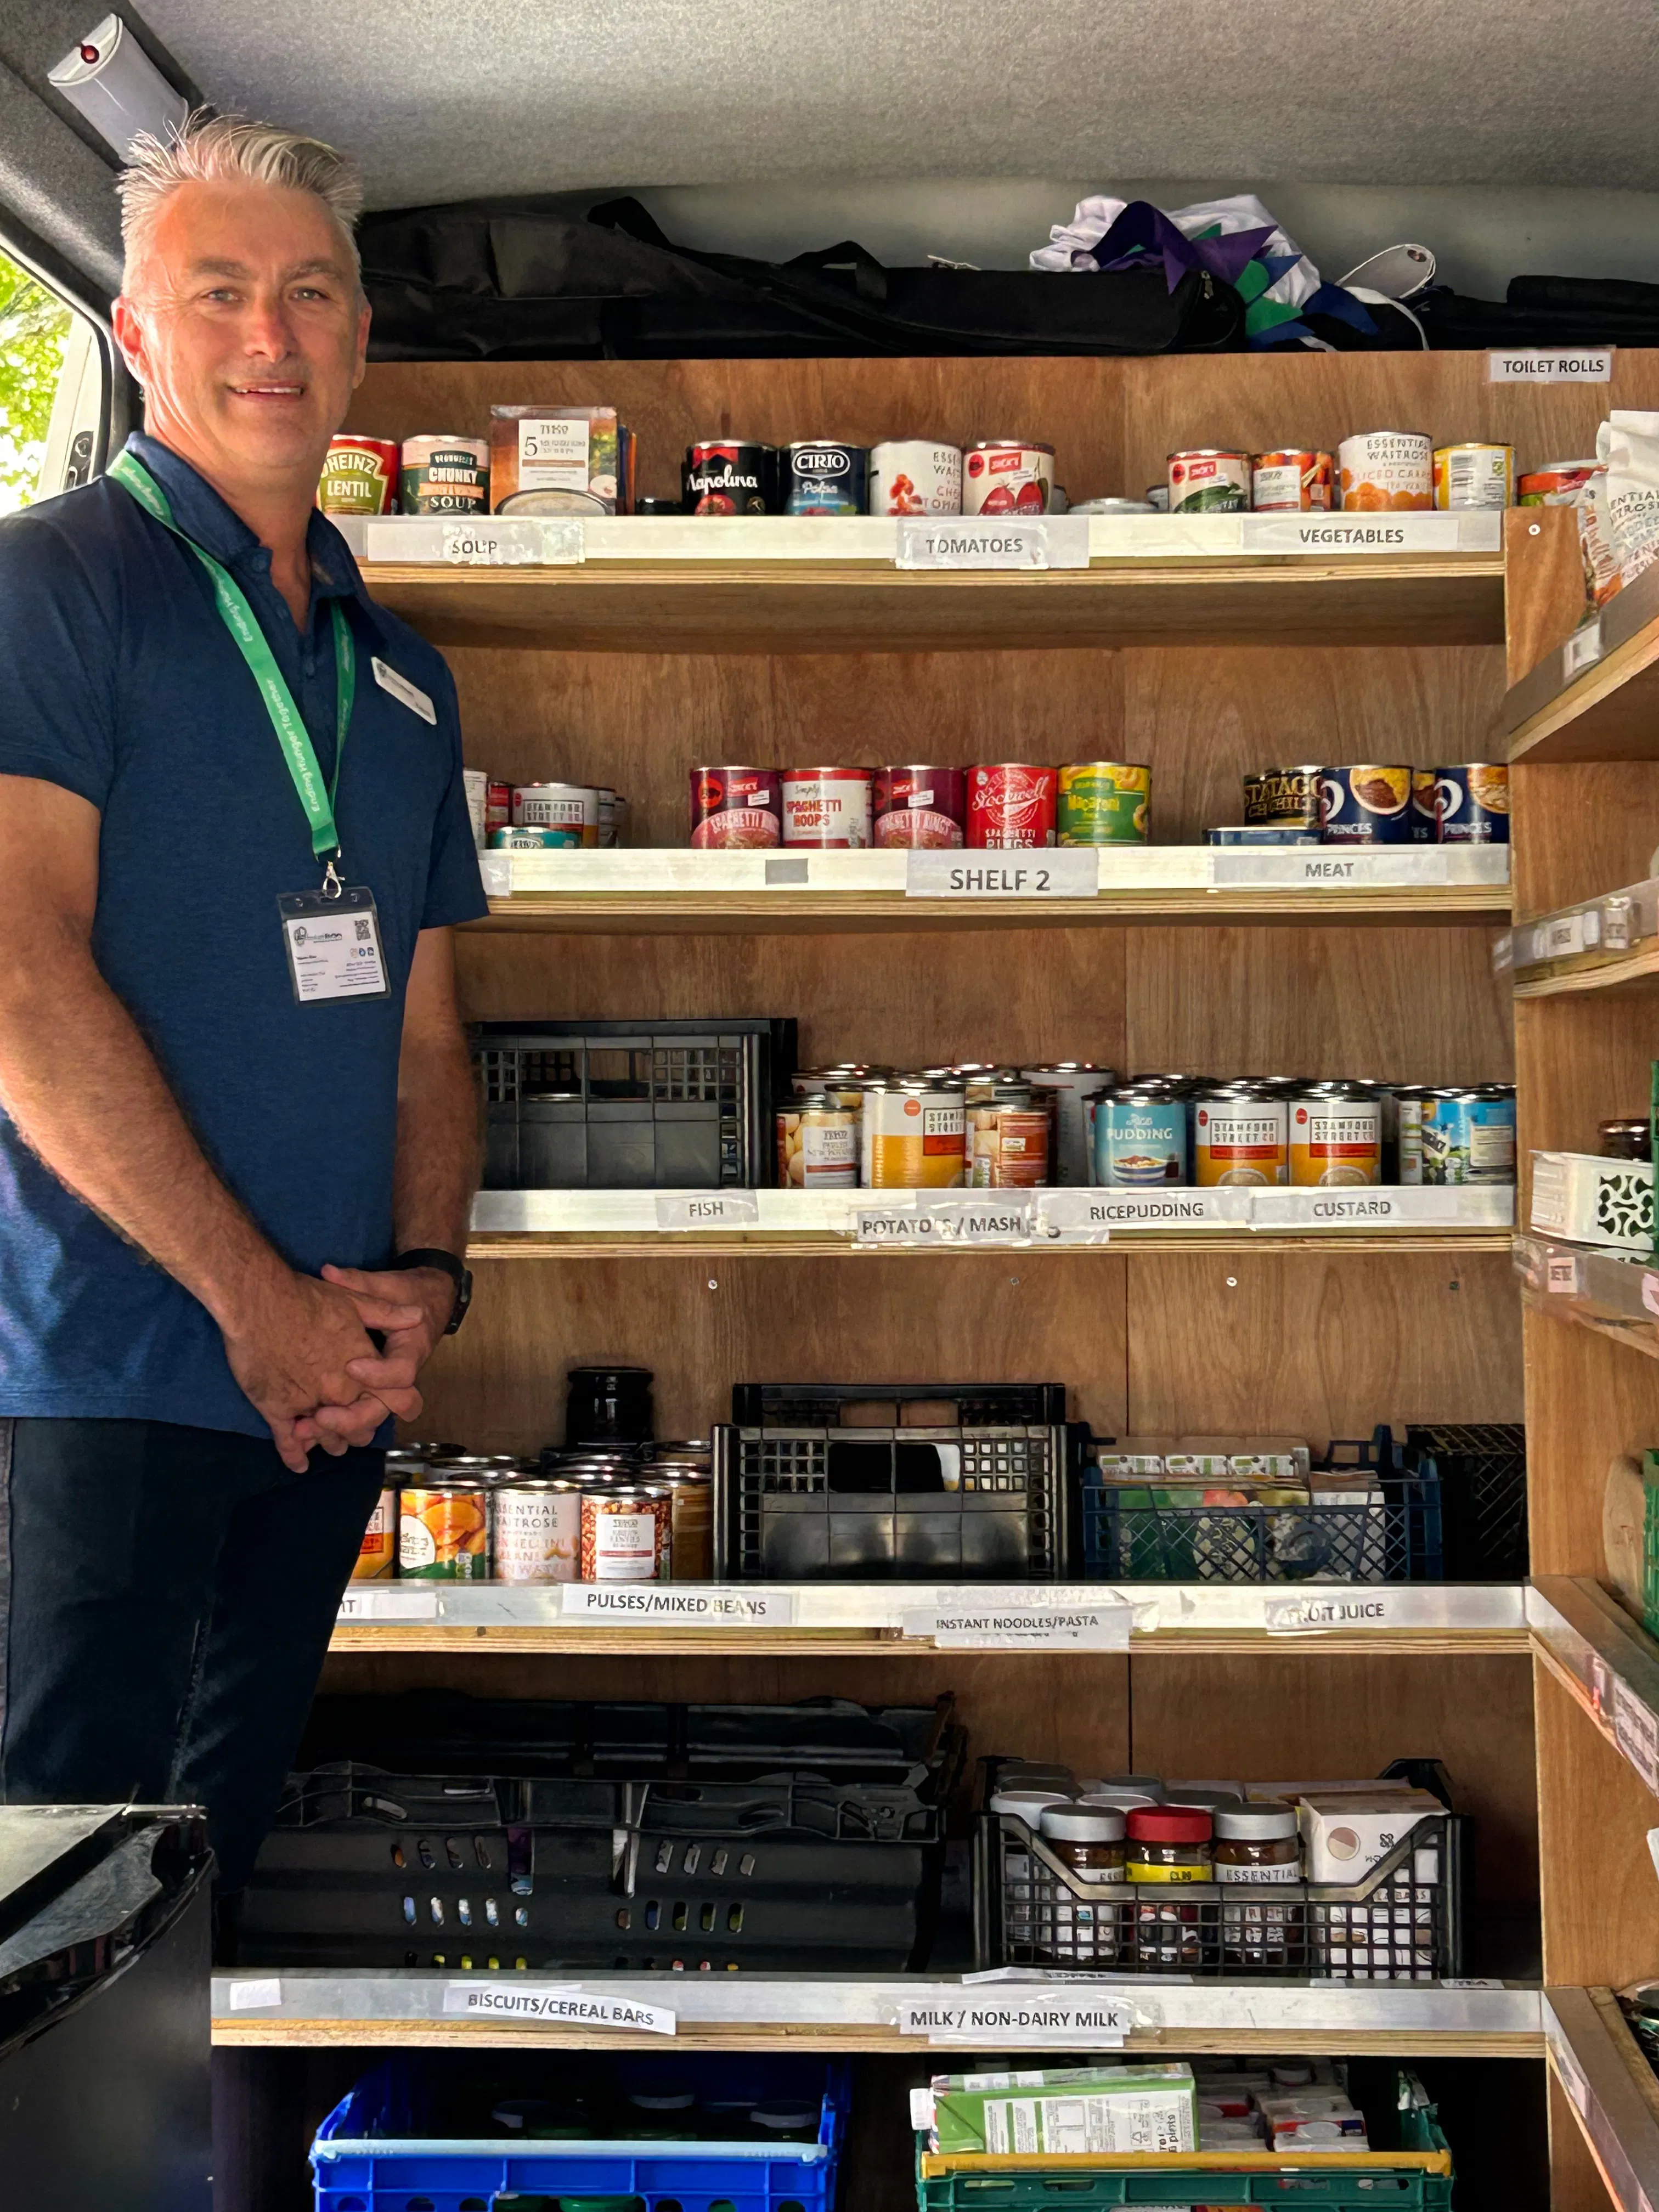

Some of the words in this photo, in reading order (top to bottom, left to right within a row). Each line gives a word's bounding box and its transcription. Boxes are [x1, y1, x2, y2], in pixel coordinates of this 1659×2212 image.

[1503, 360, 1554, 373] TOILET
[1559, 359, 1604, 373] ROLLS
[524, 436, 538, 456] 5
[329, 453, 377, 474] HEINZ
[797, 454, 845, 469] CIRIO
[428, 467, 477, 485] CHUNKY
[328, 480, 371, 498] LENTIL
[430, 495, 476, 510] SOUP
[1299, 529, 1404, 543] VEGETABLES
[452, 540, 497, 554] SOUP
[926, 538, 1023, 554] TOMATOES
[786, 799, 842, 814] SPAGHETTI
[1305, 862, 1354, 877] MEAT
[950, 869, 1027, 891] SHELF
[1036, 870, 1051, 891] 2
[1107, 1127, 1172, 1140] PUDDING
[689, 1201, 724, 1217] FISH
[1090, 1203, 1204, 1220] RICEPUDDING
[1314, 1201, 1391, 1217] CUSTARD
[863, 1217, 951, 1235] POTATO
[970, 1217, 1021, 1232] MASH
[587, 1593, 708, 1612] PULSES/MIXED
[1340, 1602, 1385, 1620] JUICE
[936, 1618, 990, 1629] INSTANT
[468, 1994, 607, 2019] BISCUITS/CEREAL
[613, 2007, 654, 2025] BARS
[911, 2011, 953, 2025] MILK
[972, 2011, 1071, 2026] NON-DAIRY
[1075, 2012, 1119, 2027] MILK
